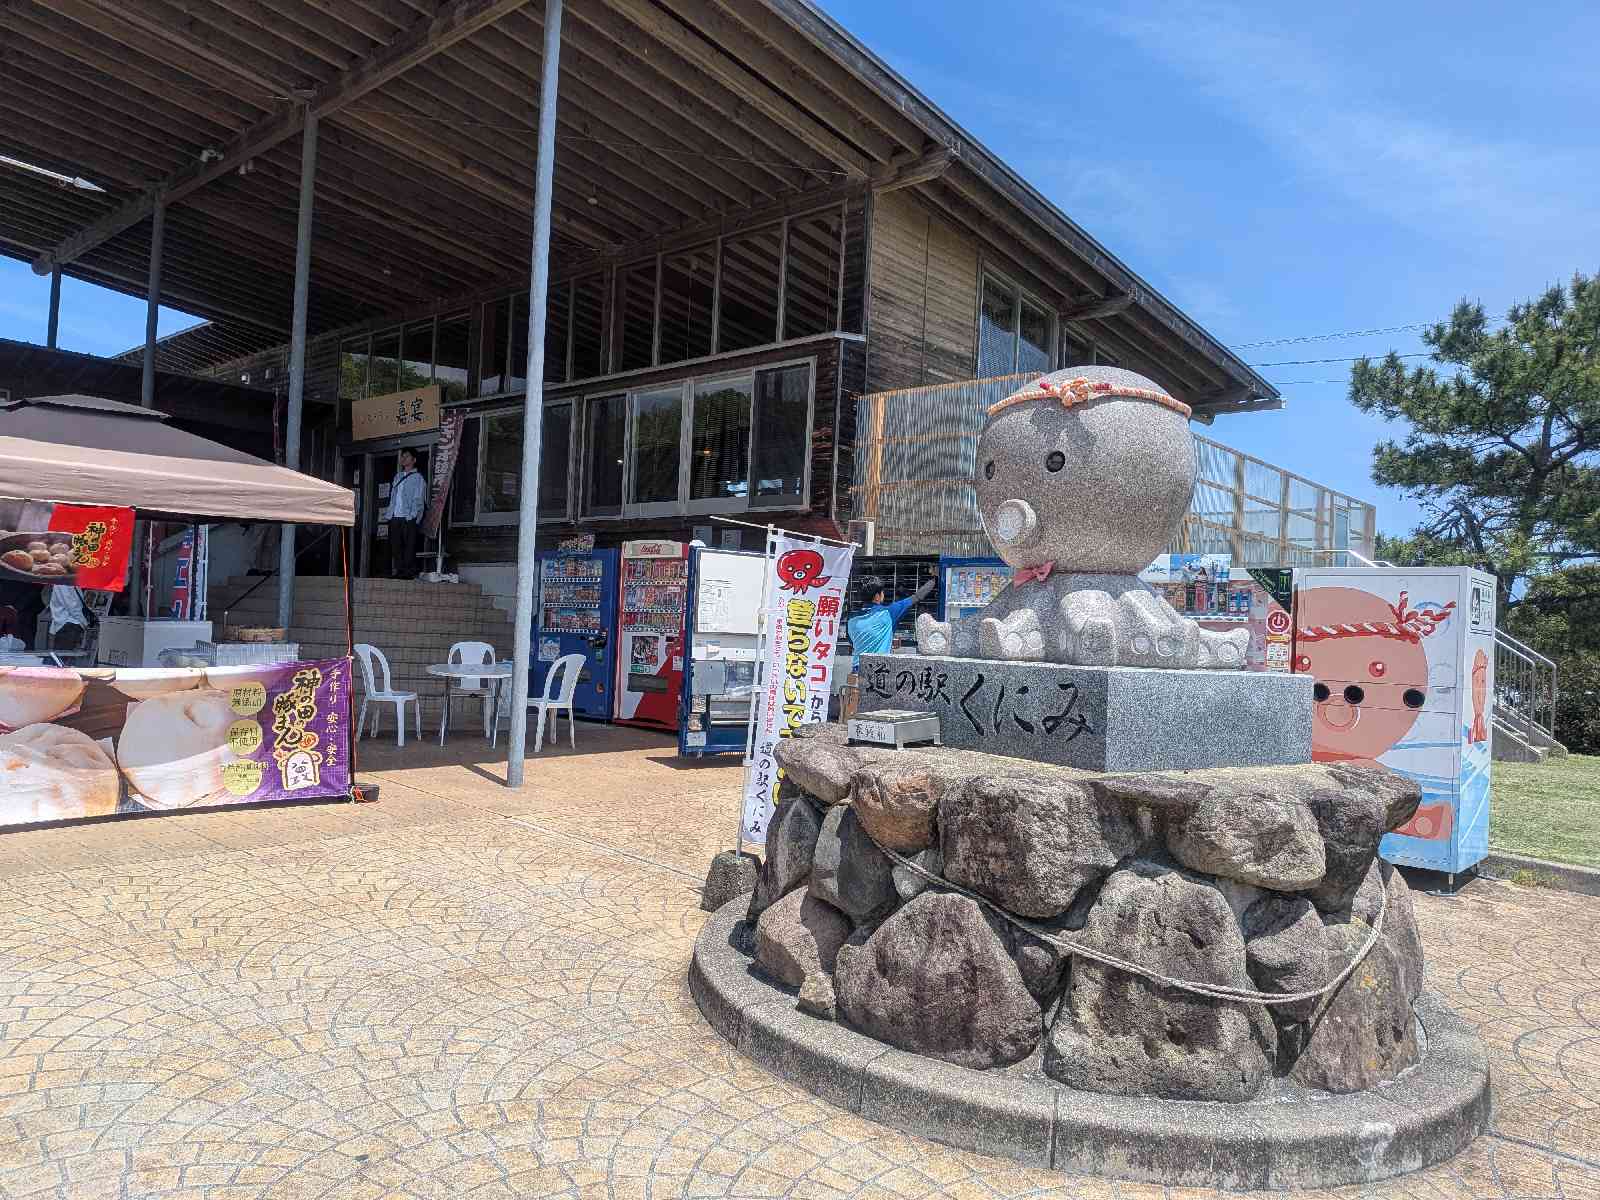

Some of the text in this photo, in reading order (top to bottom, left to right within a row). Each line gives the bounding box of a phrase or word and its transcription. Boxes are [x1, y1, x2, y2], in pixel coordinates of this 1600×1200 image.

[865, 664, 1094, 743] 道の駅 くにみ
